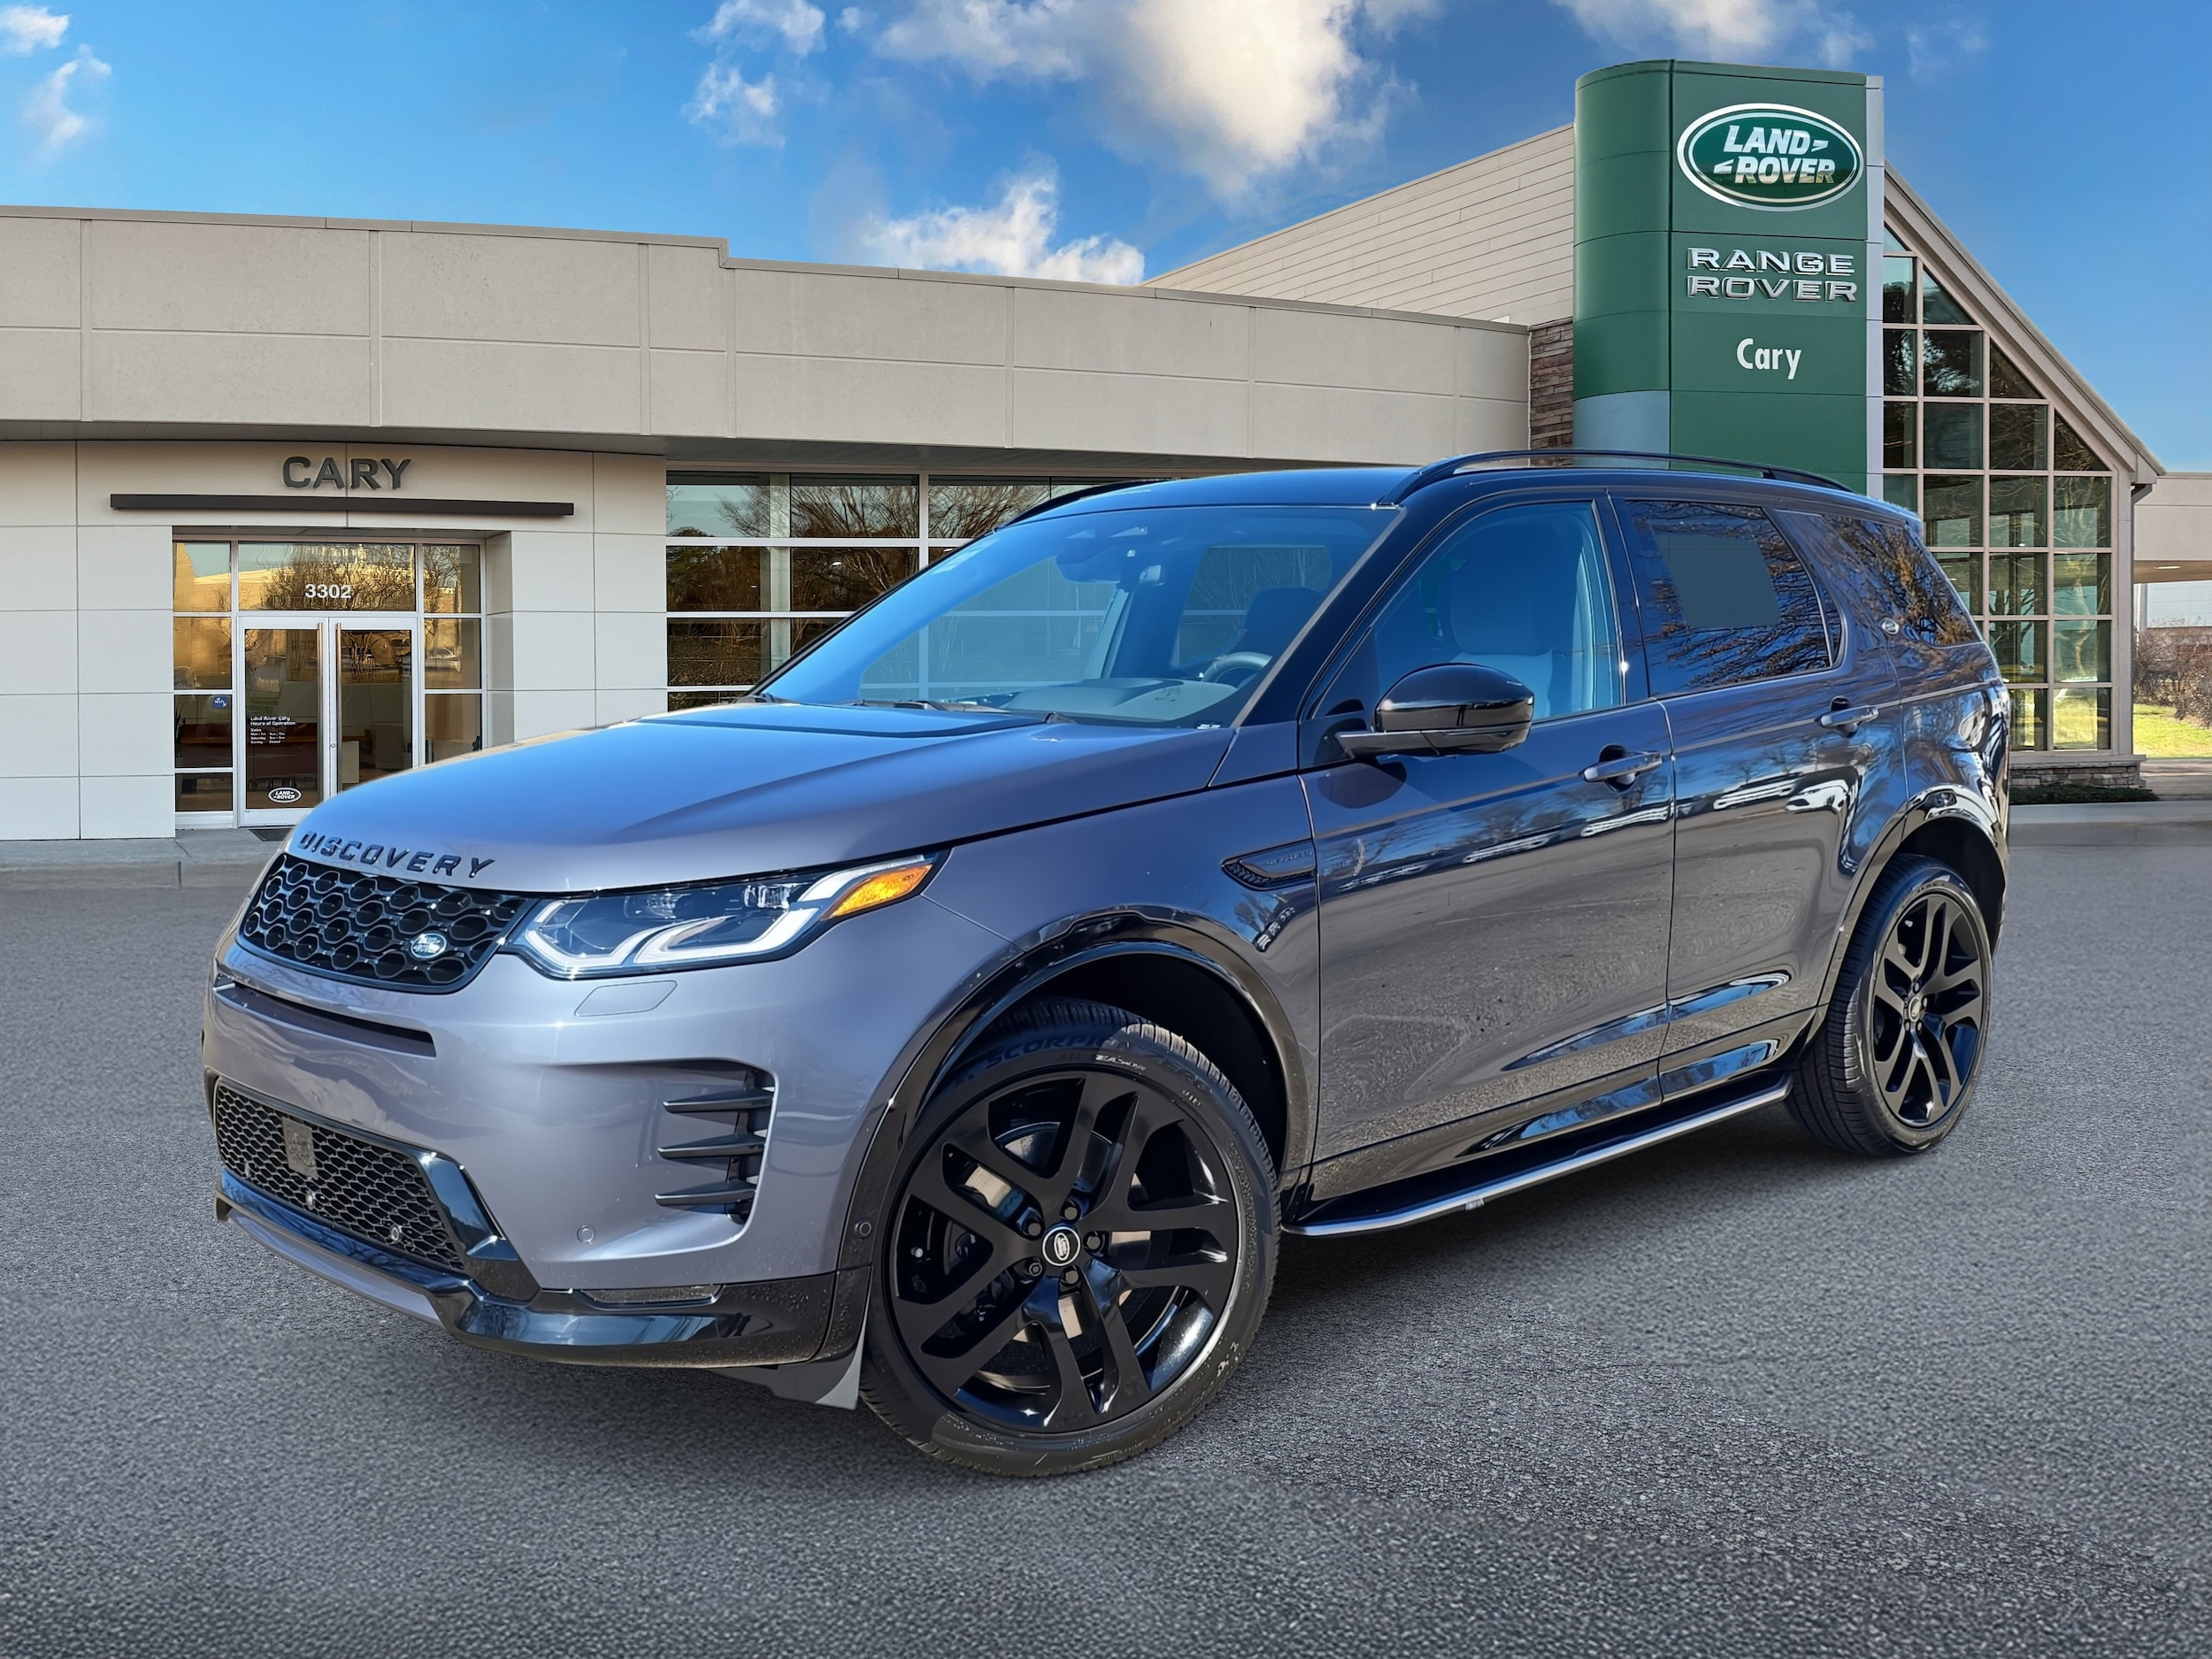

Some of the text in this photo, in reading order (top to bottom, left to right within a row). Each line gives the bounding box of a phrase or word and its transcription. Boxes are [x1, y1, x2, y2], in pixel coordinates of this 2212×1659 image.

[1723, 125, 1811, 155] LAND
[1733, 156, 1836, 184] ROVER
[1687, 247, 1856, 275] RANGE
[1687, 275, 1857, 303] ROVER
[1736, 338, 1802, 380] Cary
[281, 456, 411, 490] CARY
[305, 584, 351, 598] 3302
[297, 830, 496, 879] DISCOVERY
